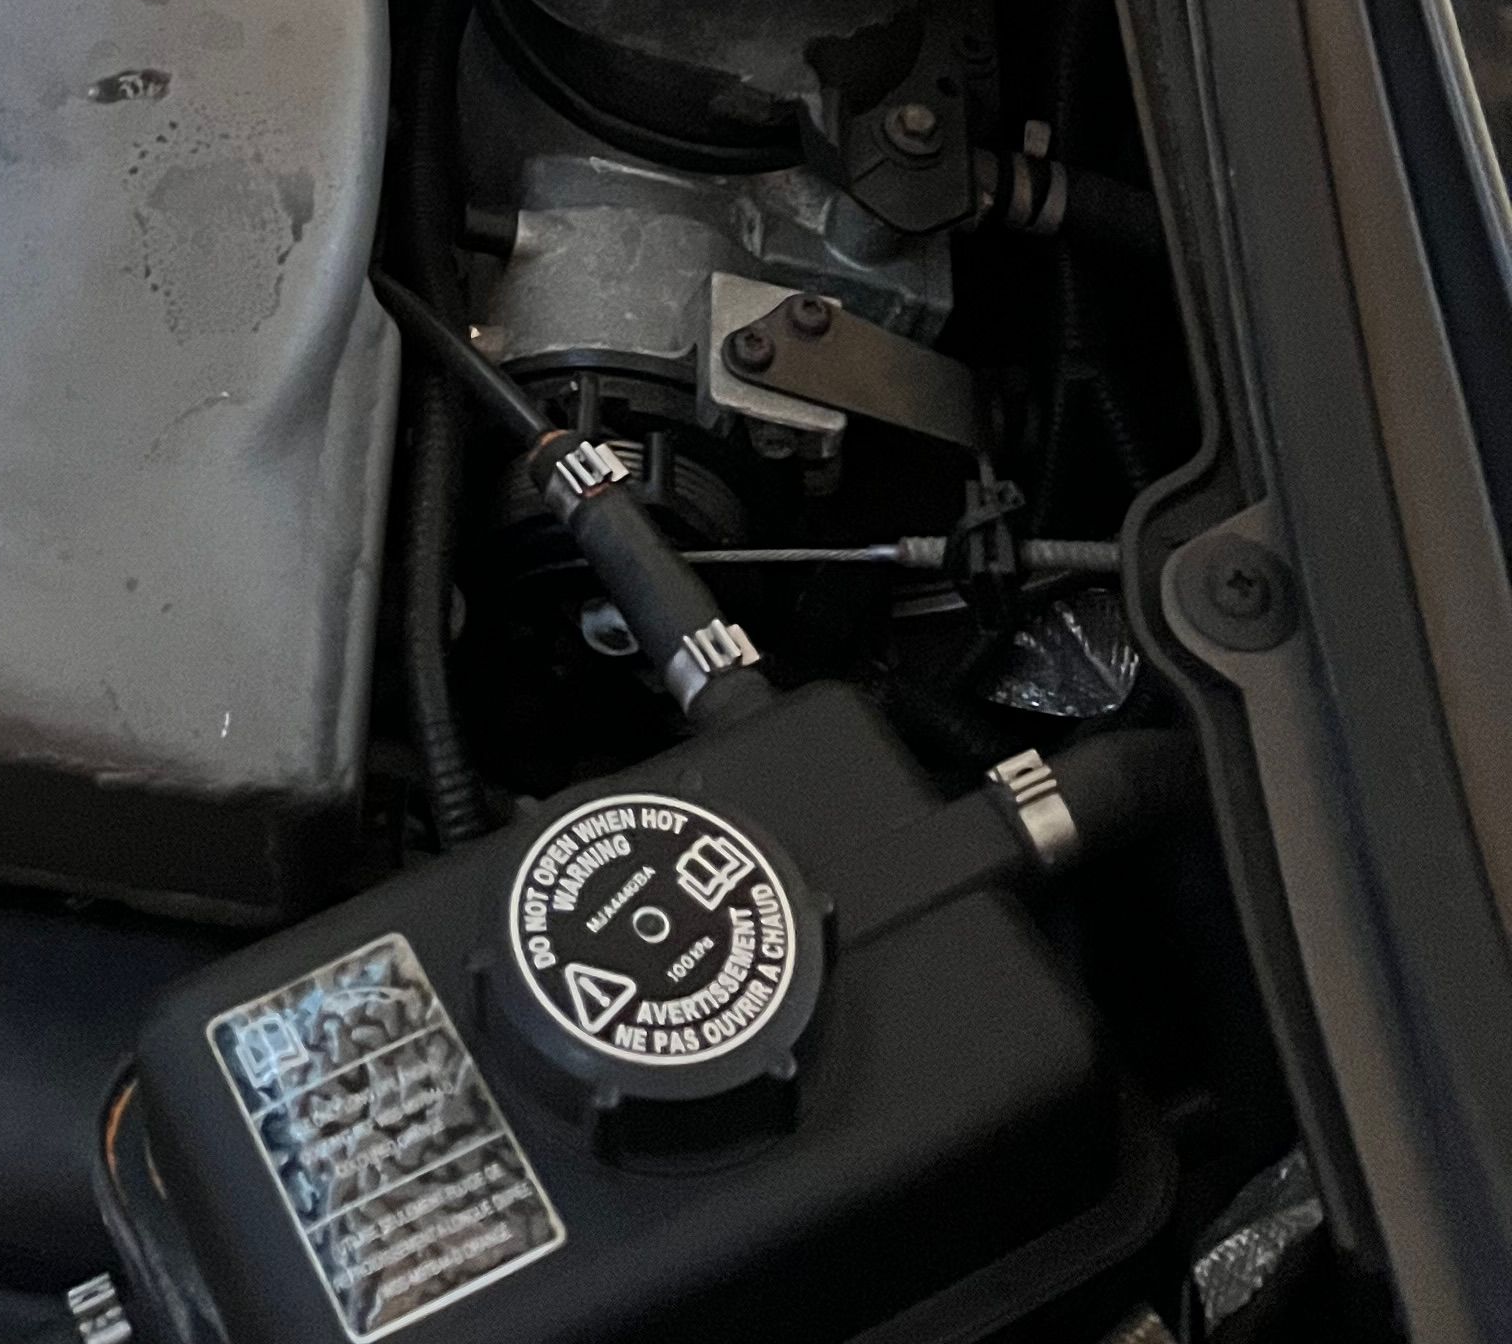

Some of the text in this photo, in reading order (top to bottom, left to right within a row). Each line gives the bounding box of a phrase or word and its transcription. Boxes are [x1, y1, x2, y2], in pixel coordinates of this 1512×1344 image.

[525, 807, 688, 969] DO NOT OPEN WHEN HOT
[553, 833, 631, 911] WARNING
[615, 884, 785, 1054] NE PAS OUVRIR A CHAUD
[637, 906, 756, 1025] AVERTISSEMENT
